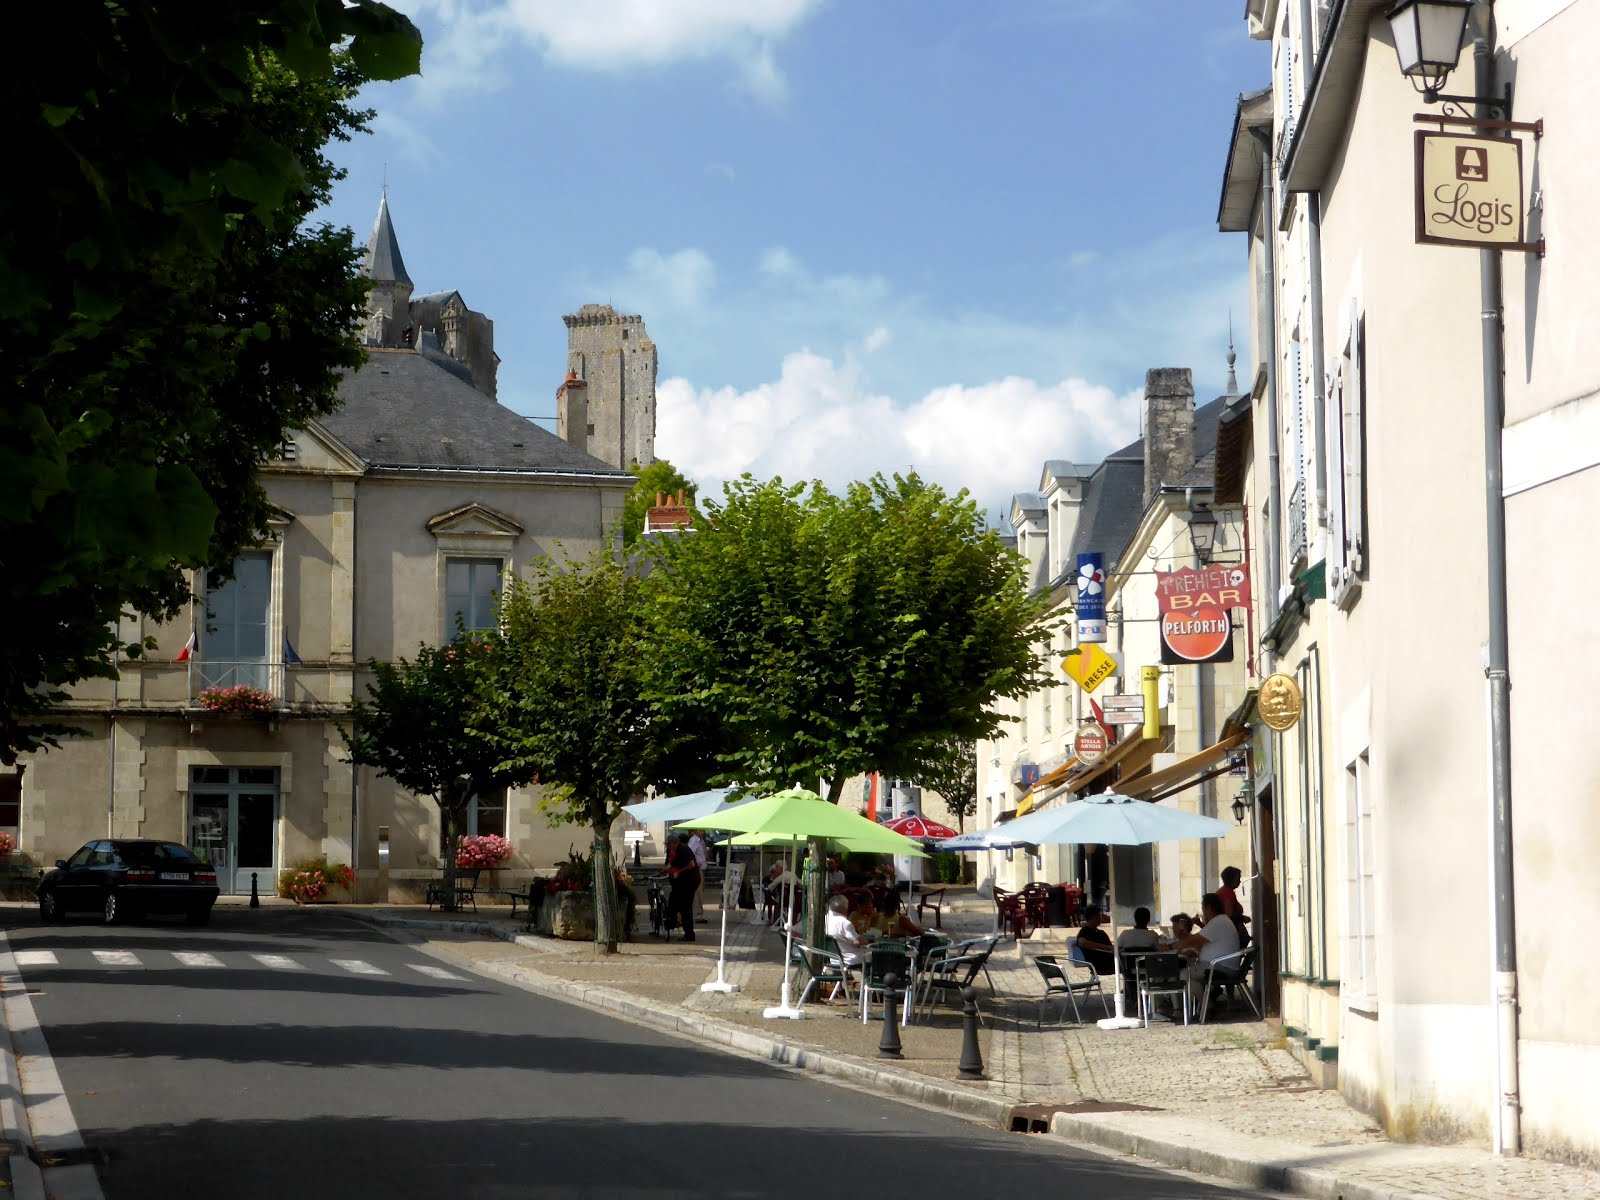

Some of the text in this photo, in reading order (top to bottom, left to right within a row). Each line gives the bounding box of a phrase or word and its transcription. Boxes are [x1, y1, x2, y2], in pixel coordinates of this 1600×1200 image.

[1431, 182, 1513, 234] Logis
[1170, 590, 1241, 610] BAR
[1166, 619, 1226, 636] PELFORTH
[1084, 660, 1112, 689] PRESSE
